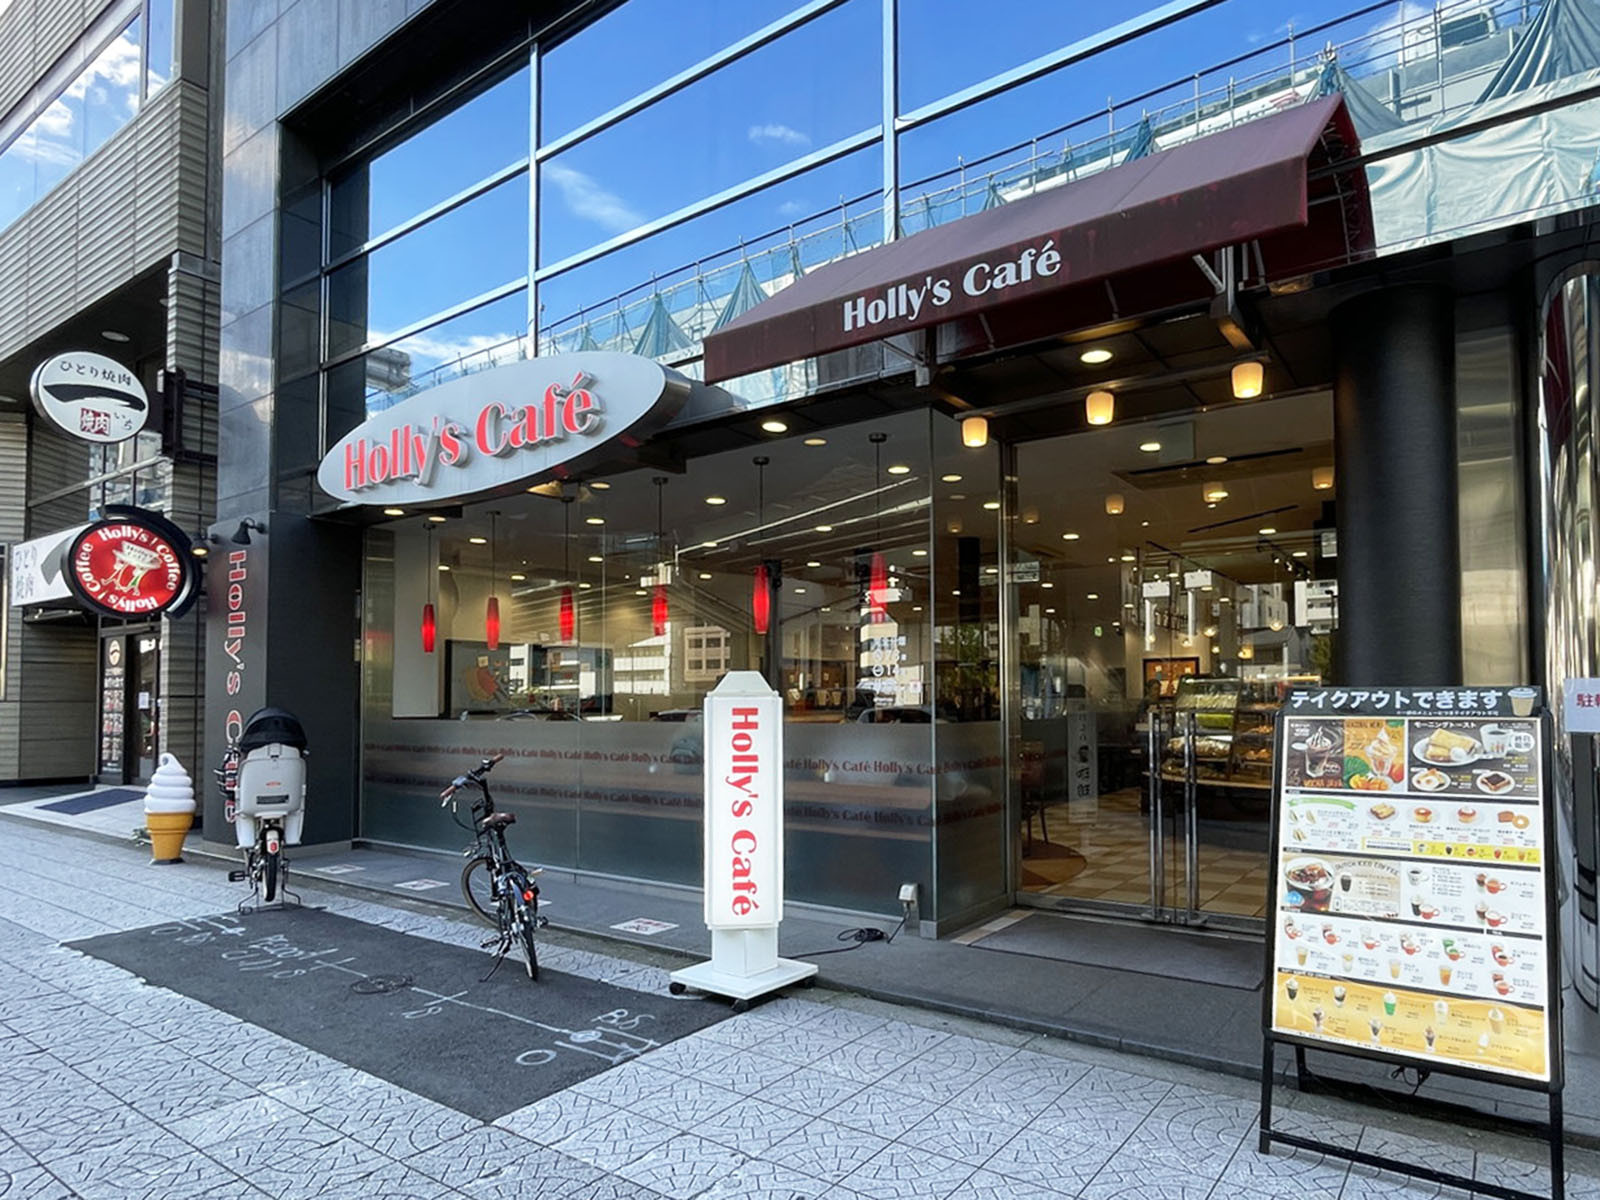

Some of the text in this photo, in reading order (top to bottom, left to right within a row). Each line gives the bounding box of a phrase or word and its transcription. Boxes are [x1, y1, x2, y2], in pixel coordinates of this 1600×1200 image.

[842, 240, 1062, 332] Holly's Café
[60, 361, 132, 386] ひとり焼肉
[344, 370, 600, 491] Holly's Café
[224, 550, 247, 824] Holly's Ca
[1290, 690, 1503, 710] テイクアウトできます
[1413, 721, 1477, 729] モーニングトースト
[804, 758, 839, 773] Holly's
[841, 760, 871, 773] Café
[873, 761, 914, 775] Holly's
[725, 707, 760, 916] Holly's Café
